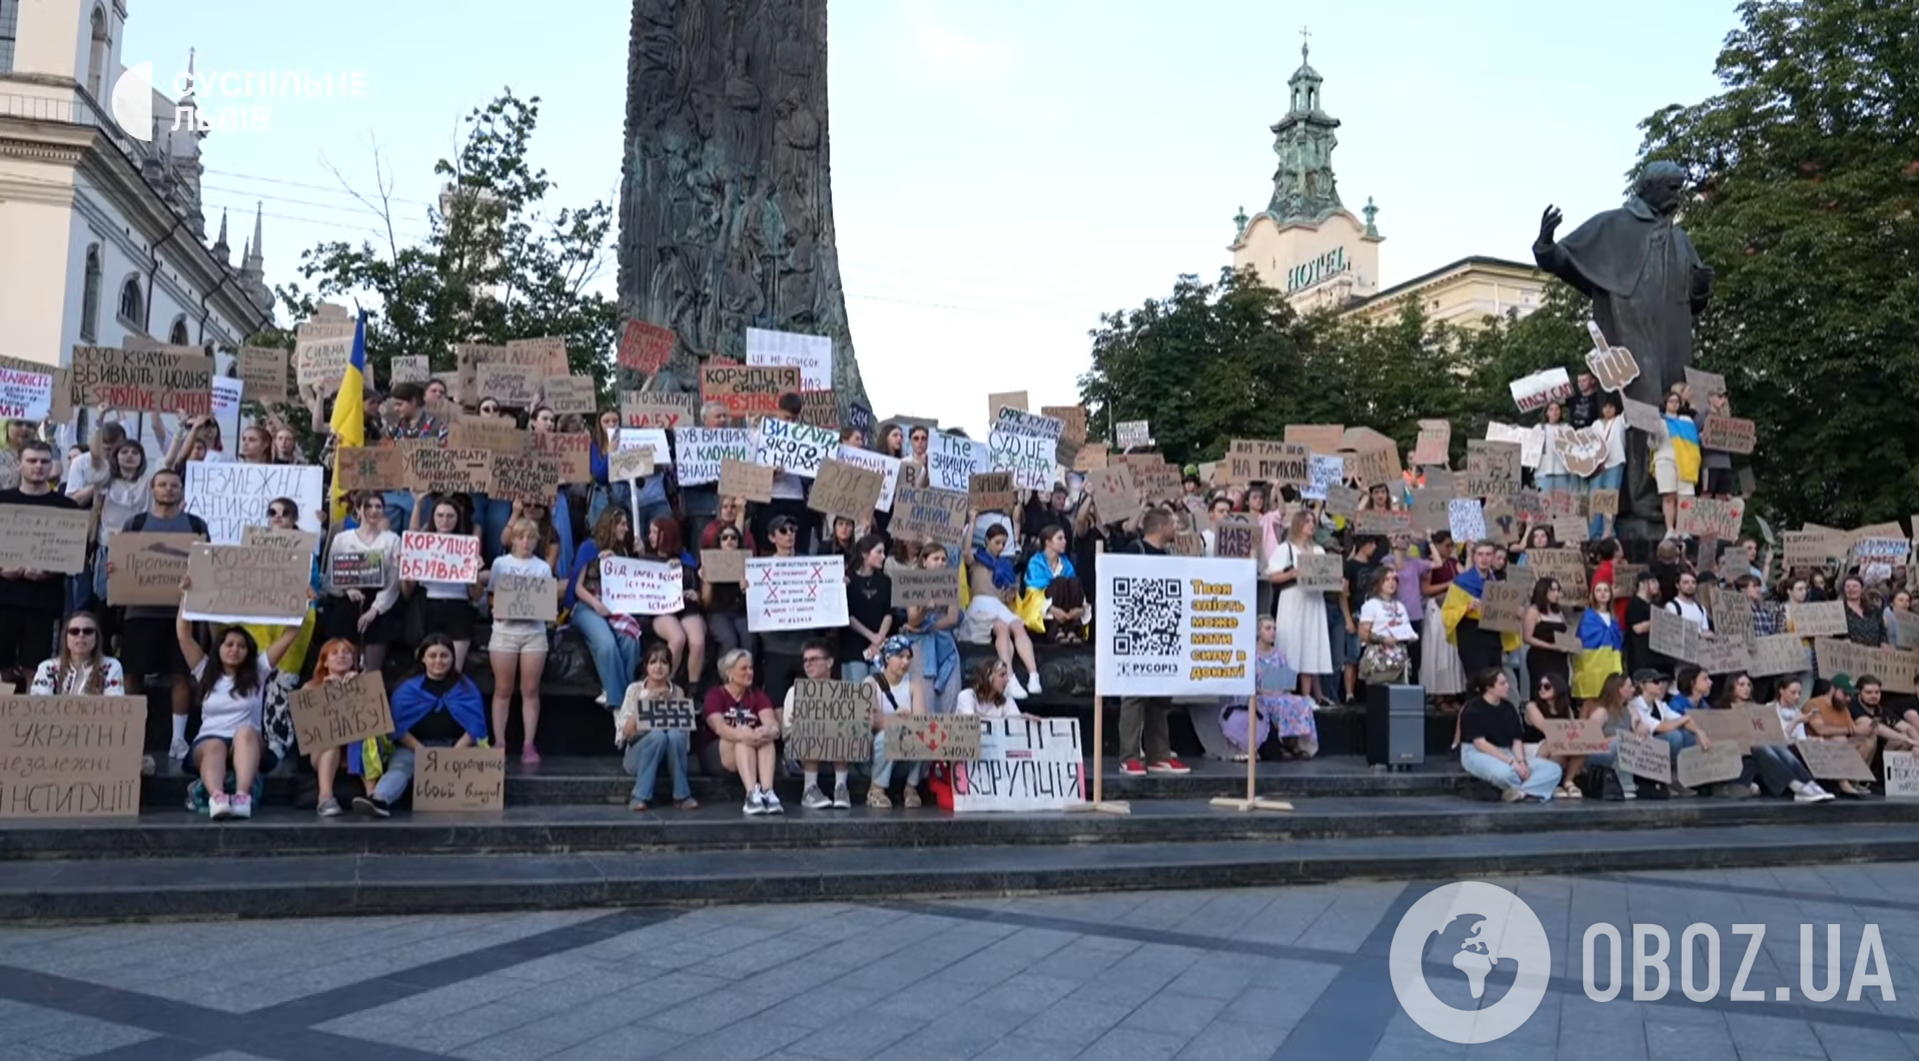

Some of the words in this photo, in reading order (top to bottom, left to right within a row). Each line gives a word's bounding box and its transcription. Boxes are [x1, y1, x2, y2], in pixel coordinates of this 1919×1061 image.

[1287, 245, 1346, 293] HOTEL
[74, 346, 114, 365] МОЮ
[123, 349, 182, 370] КРАЇНУ
[73, 364, 155, 387] ВБИВАЮТЬ
[159, 368, 210, 392] ЩОДНЯ
[705, 368, 797, 387] КОРУПЦІЯ
[732, 381, 780, 395] СМЕРТЬ
[71, 382, 91, 408] ЦЕ
[92, 384, 156, 411] SENSITIVE
[160, 390, 214, 416] CONTENT
[629, 411, 680, 428] НАБУ
[764, 437, 818, 460] ЯКОГО
[941, 433, 972, 457] The
[989, 431, 1021, 457] СУД
[1237, 442, 1254, 455] ВИ
[1257, 443, 1283, 456] ТАМ
[697, 447, 747, 462] КЛОУНИ
[931, 452, 977, 476] ЗНИЩУЄ
[492, 467, 541, 483] СИСТЕМА
[1232, 458, 1251, 478] НА
[1259, 458, 1307, 480] ПРИКОЛІ
[190, 466, 305, 498] НЕЗАЛЕЖНІ
[498, 479, 545, 497] ПРАЦЮЄ
[941, 471, 969, 491] ВСЕ
[976, 475, 1009, 493] ЗМІНИ
[898, 488, 920, 506] НАС
[187, 495, 270, 521] АНТИКОР
[1217, 526, 1252, 541] НАБУ
[1217, 542, 1253, 558] НАБУ
[1190, 579, 1233, 597] Твоя
[1190, 597, 1246, 614] злість
[1190, 615, 1240, 631] може
[1190, 632, 1234, 647] мати
[1190, 649, 1234, 666] силу
[1236, 650, 1248, 663] в
[1133, 662, 1178, 675] РУСОРІЗ
[1189, 664, 1246, 682] донаті
[794, 680, 873, 700] ПОТУЖНО
[793, 699, 856, 721] БОРЕМОСЯ
[9, 721, 128, 749] УКРАЇНІ
[790, 737, 871, 761] КОРУПЦІЄЮ
[424, 749, 439, 772] Я
